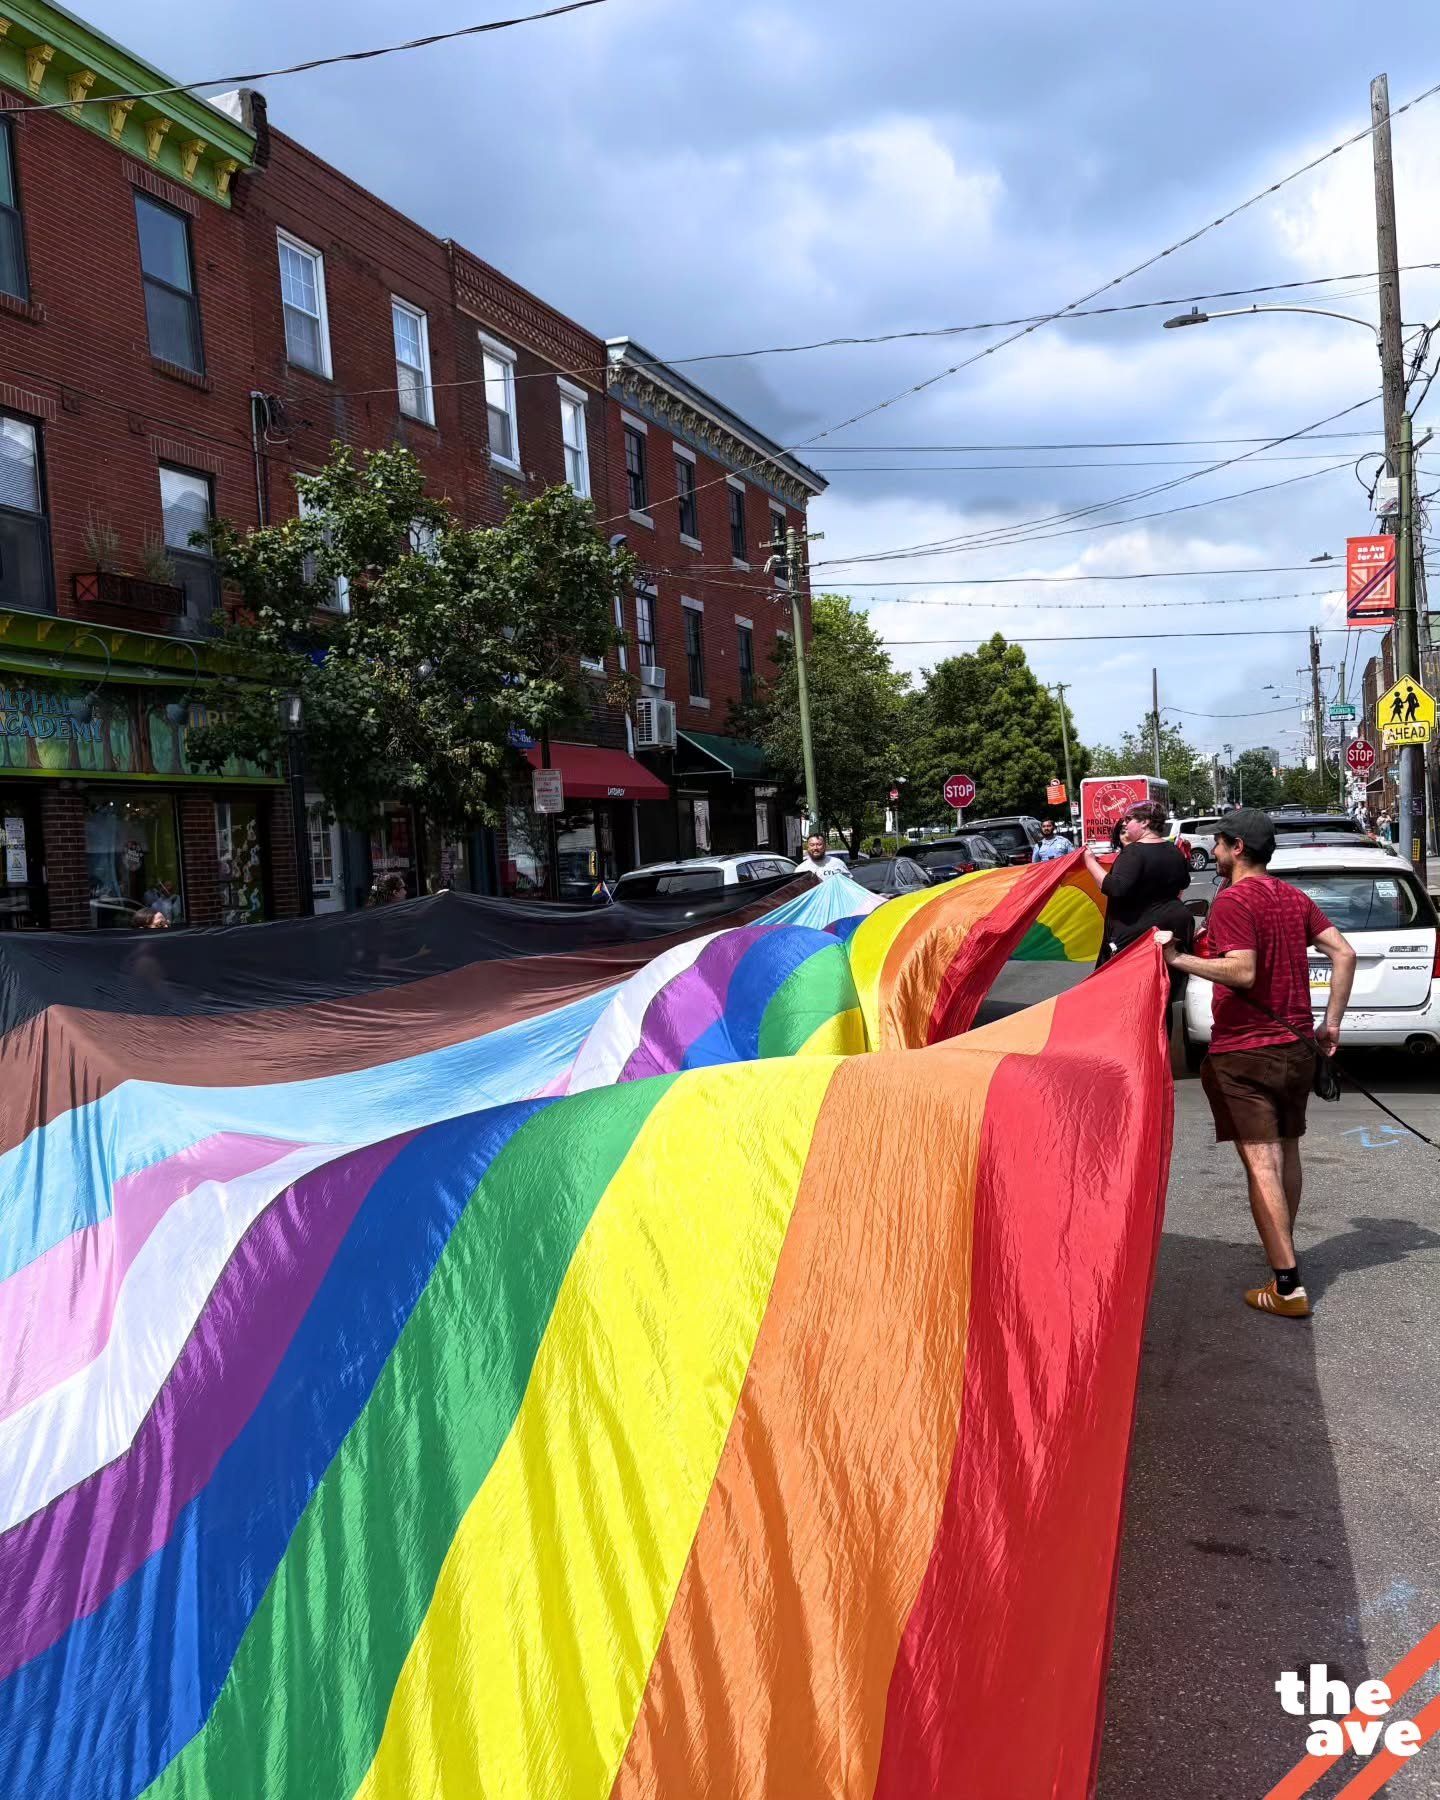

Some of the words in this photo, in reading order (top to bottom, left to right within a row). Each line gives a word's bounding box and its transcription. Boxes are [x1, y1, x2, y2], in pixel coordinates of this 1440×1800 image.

[1369, 544, 1385, 552] Ave
[1387, 726, 1426, 741] AHEAD
[1348, 749, 1374, 762] STOP
[946, 784, 973, 798] STOP
[1086, 817, 1117, 826] PROUDLY
